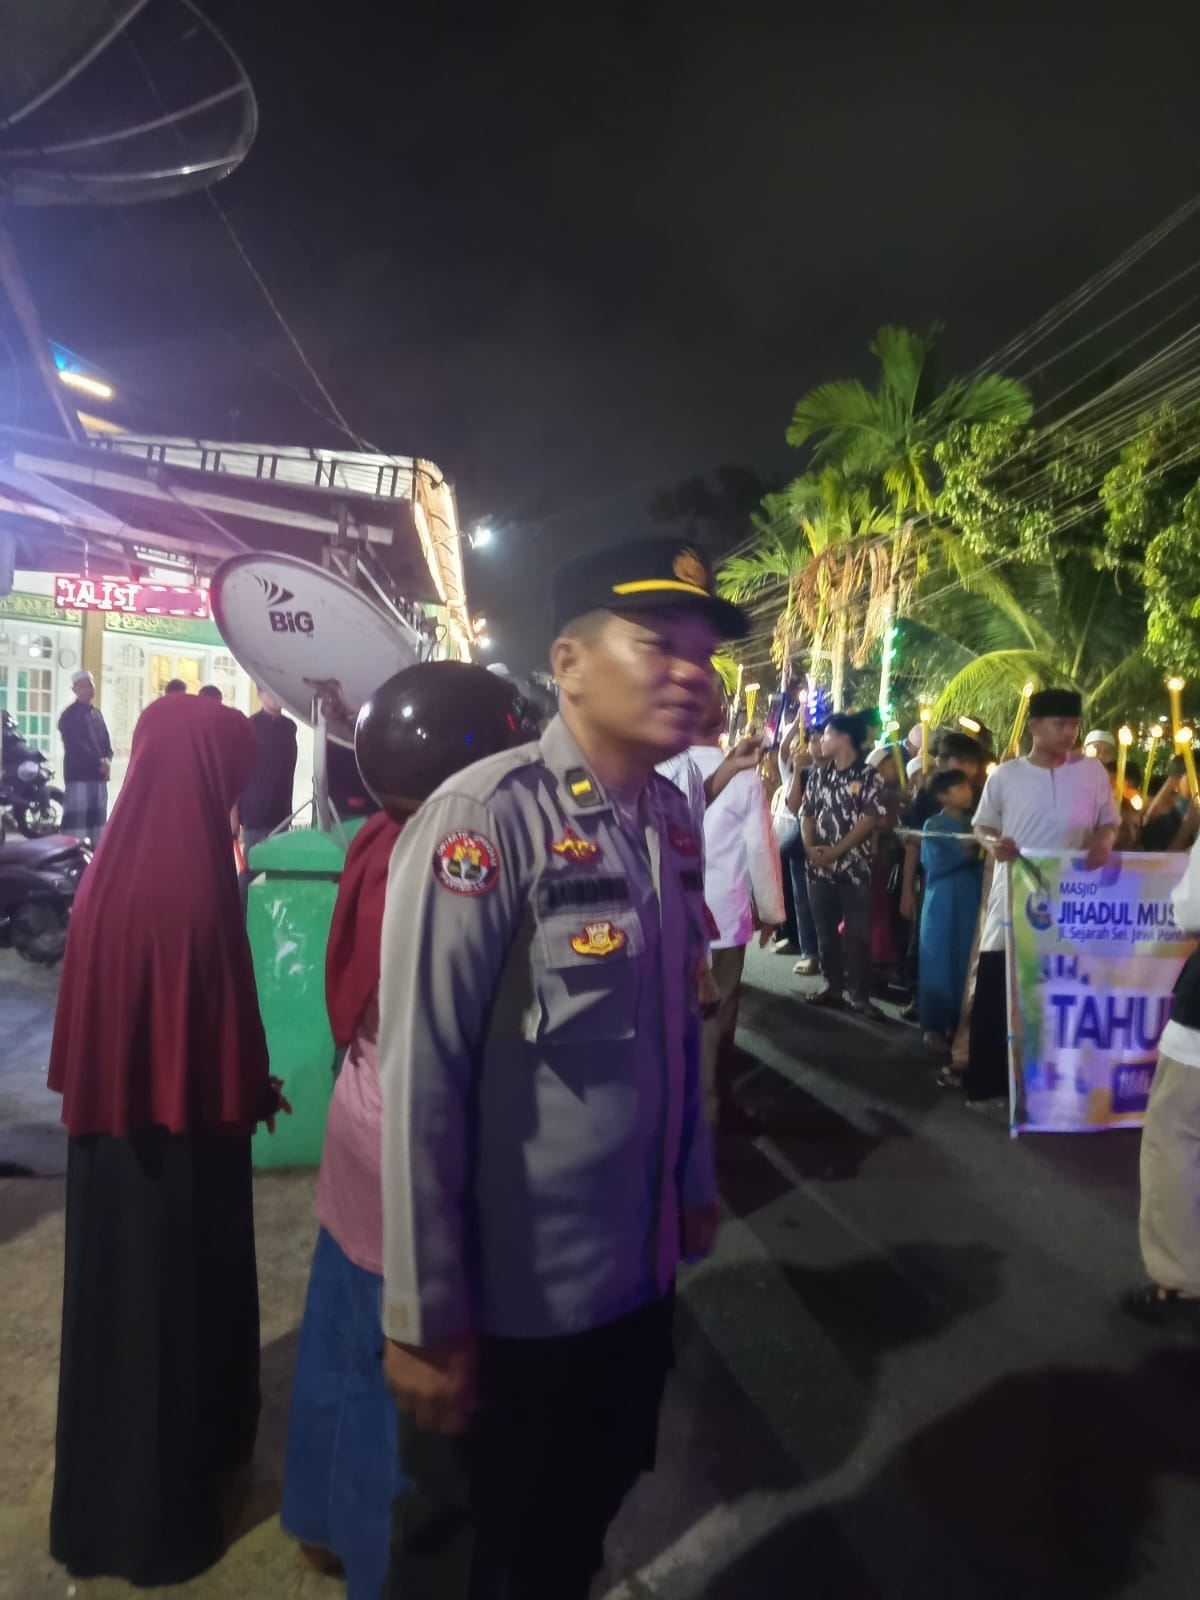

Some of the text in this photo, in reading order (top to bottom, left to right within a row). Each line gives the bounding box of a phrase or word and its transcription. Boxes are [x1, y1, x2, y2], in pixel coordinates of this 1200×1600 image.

[1059, 882, 1098, 897] MASJID
[1058, 901, 1132, 925] JIHADUL
[1070, 926, 1110, 942] Sejarah
